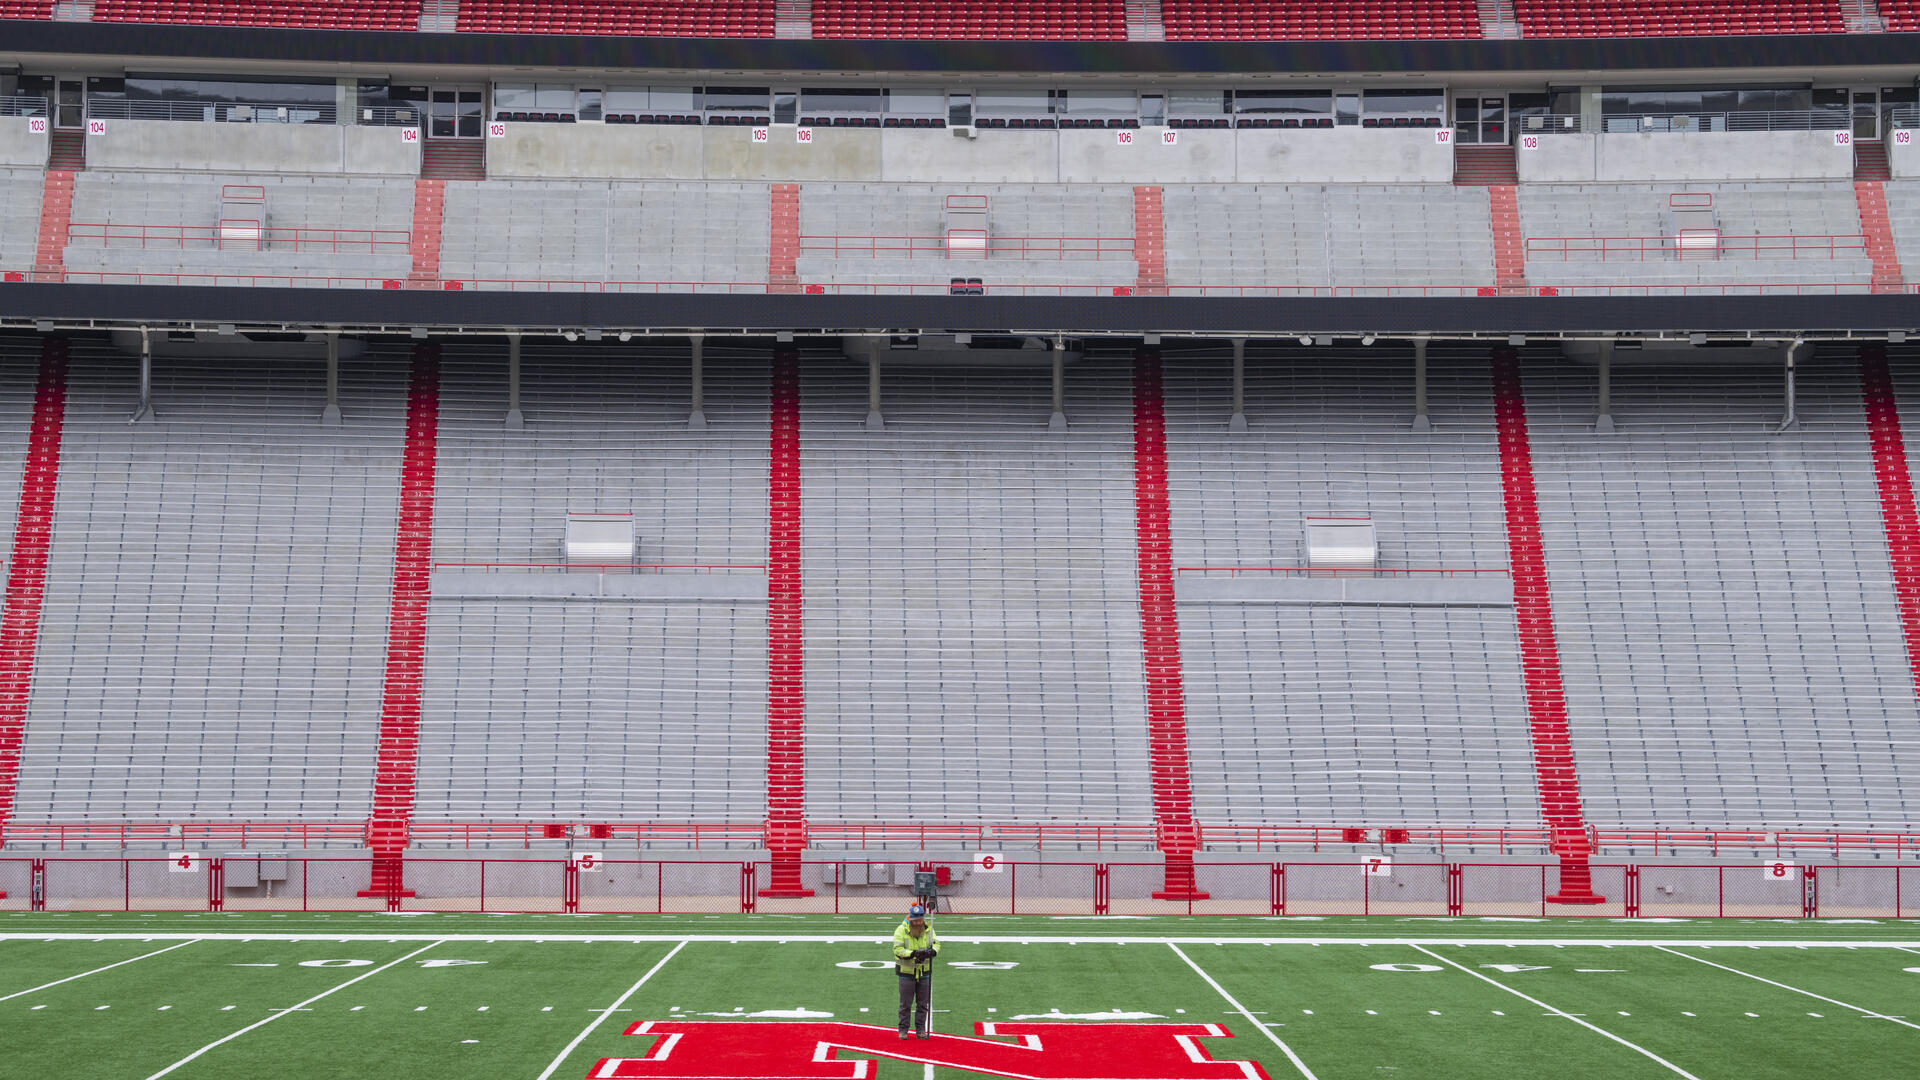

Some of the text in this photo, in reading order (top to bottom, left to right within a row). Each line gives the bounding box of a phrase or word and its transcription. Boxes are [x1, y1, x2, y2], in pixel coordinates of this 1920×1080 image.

[31, 120, 45, 131] 103
[90, 122, 104, 133] 104
[490, 125, 504, 136] 105
[403, 130, 417, 141] 104
[753, 130, 767, 141] 105
[798, 130, 811, 141] 106
[1118, 132, 1132, 143] 106
[1163, 132, 1177, 143] 107
[1437, 131, 1450, 142] 107
[1835, 133, 1849, 144] 108
[1895, 132, 1910, 143] 109
[1523, 137, 1537, 148] 108
[177, 855, 191, 869] 4
[582, 855, 594, 869] 5
[982, 856, 994, 869] 6
[1369, 859, 1382, 872] 7
[1773, 863, 1786, 877] 8
[586, 1020, 1273, 1080] N
